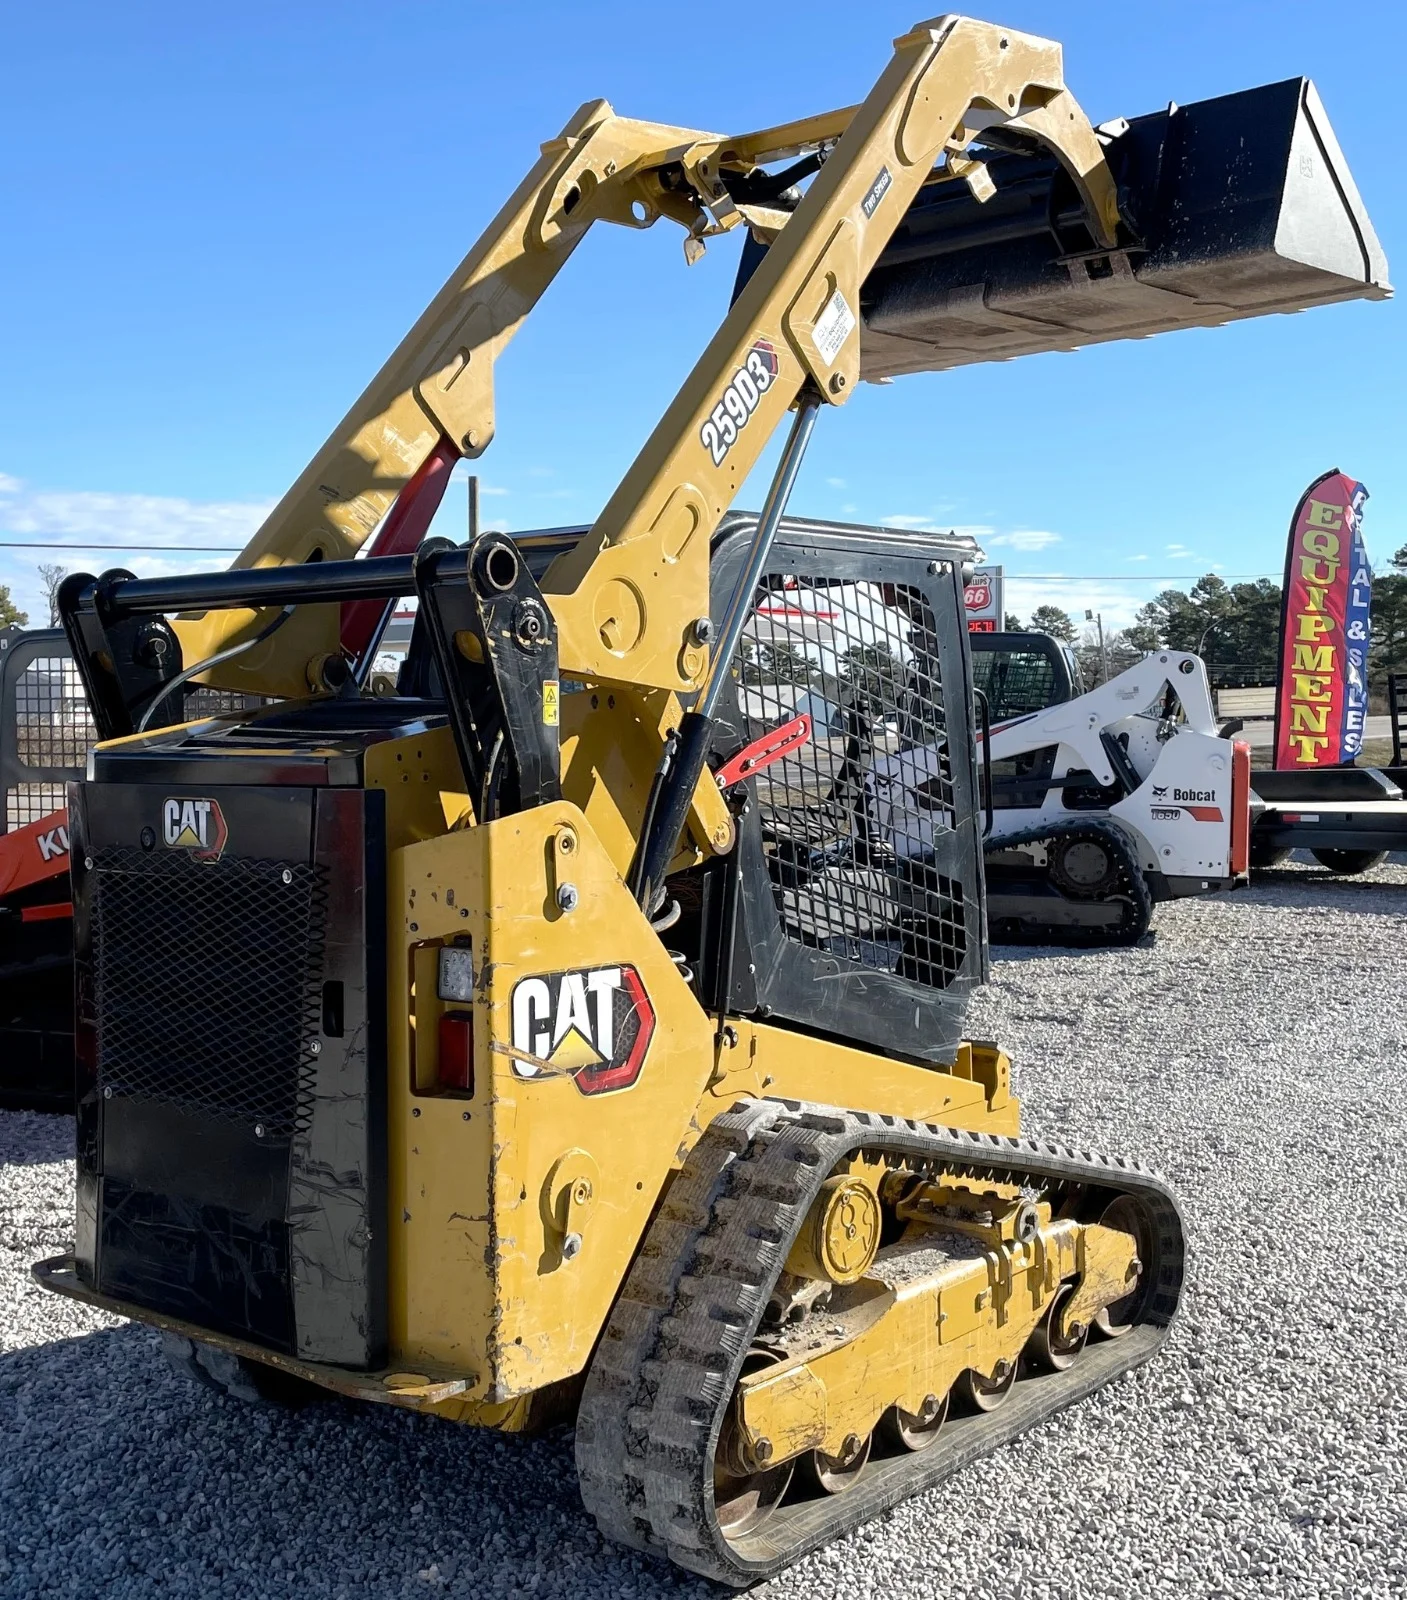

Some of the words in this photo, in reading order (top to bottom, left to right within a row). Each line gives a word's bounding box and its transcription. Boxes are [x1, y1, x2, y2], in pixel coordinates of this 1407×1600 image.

[701, 351, 771, 466] 259D3
[964, 588, 985, 605] 66
[1288, 499, 1344, 763] EQUIPMENT
[1347, 620, 1366, 641] &
[1174, 789, 1216, 802] Bobcat
[164, 799, 210, 848] CAT
[1151, 809, 1180, 821] T650
[513, 968, 621, 1077] CAT
